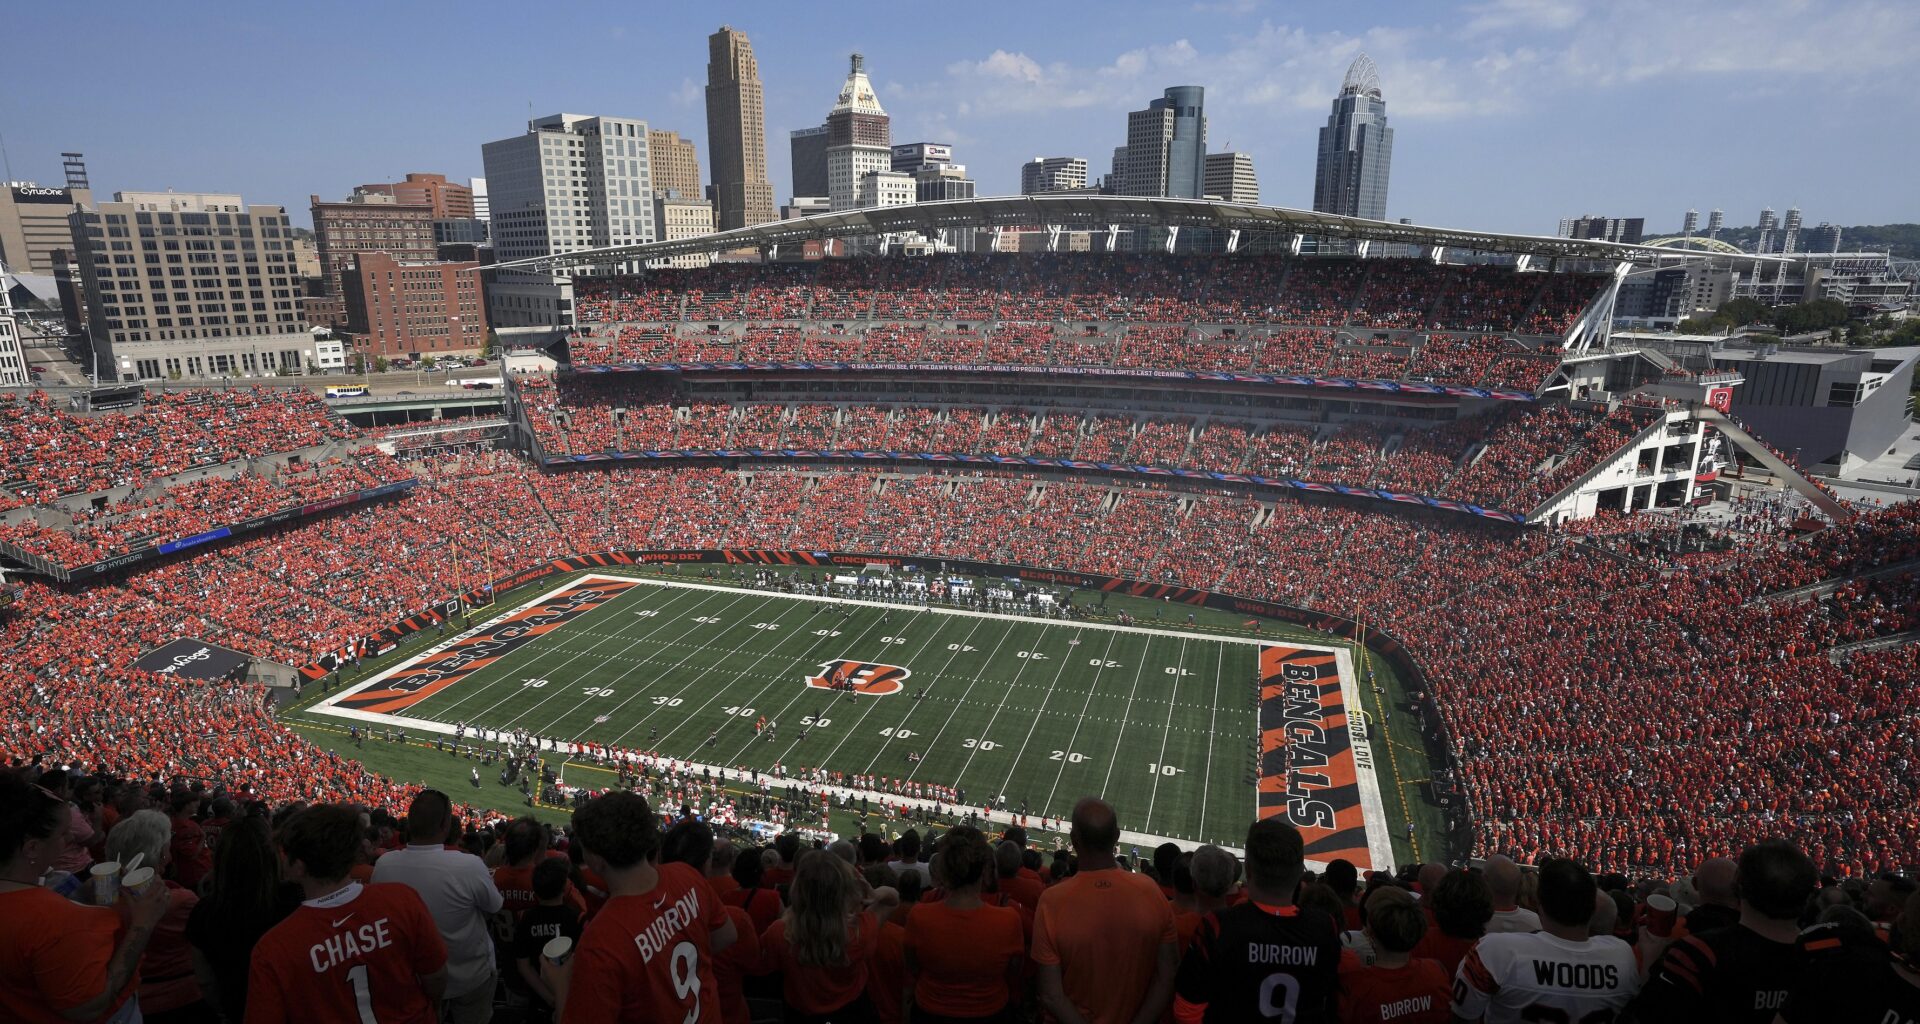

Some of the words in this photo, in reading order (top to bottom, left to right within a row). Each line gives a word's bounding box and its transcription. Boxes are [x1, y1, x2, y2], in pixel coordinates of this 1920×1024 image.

[20, 187, 63, 196] CyrusOne
[108, 553, 143, 568] HYUNDAI
[679, 553, 703, 561] DEY
[493, 579, 513, 593] THE
[514, 565, 553, 586] JUNGLE
[388, 589, 604, 693] BENGALS
[522, 678, 549, 688] 10
[584, 687, 615, 697] 20
[652, 696, 684, 707] 30
[725, 706, 756, 717] 40
[799, 715, 832, 728] 50
[879, 727, 911, 740] 40
[962, 738, 995, 751] 30
[1281, 662, 1336, 830] BENGALS
[1049, 750, 1084, 763] 20
[1354, 745, 1372, 770] LOVE
[1148, 763, 1177, 776] 10
[634, 887, 700, 965] BURROW
[309, 917, 392, 973] CHASE
[1248, 942, 1319, 967] BURROW
[670, 941, 701, 1024] 9
[1532, 959, 1618, 990] WOODS
[345, 964, 378, 1024] 1
[1258, 972, 1301, 1024] 9
[1380, 995, 1432, 1021] BURROW
